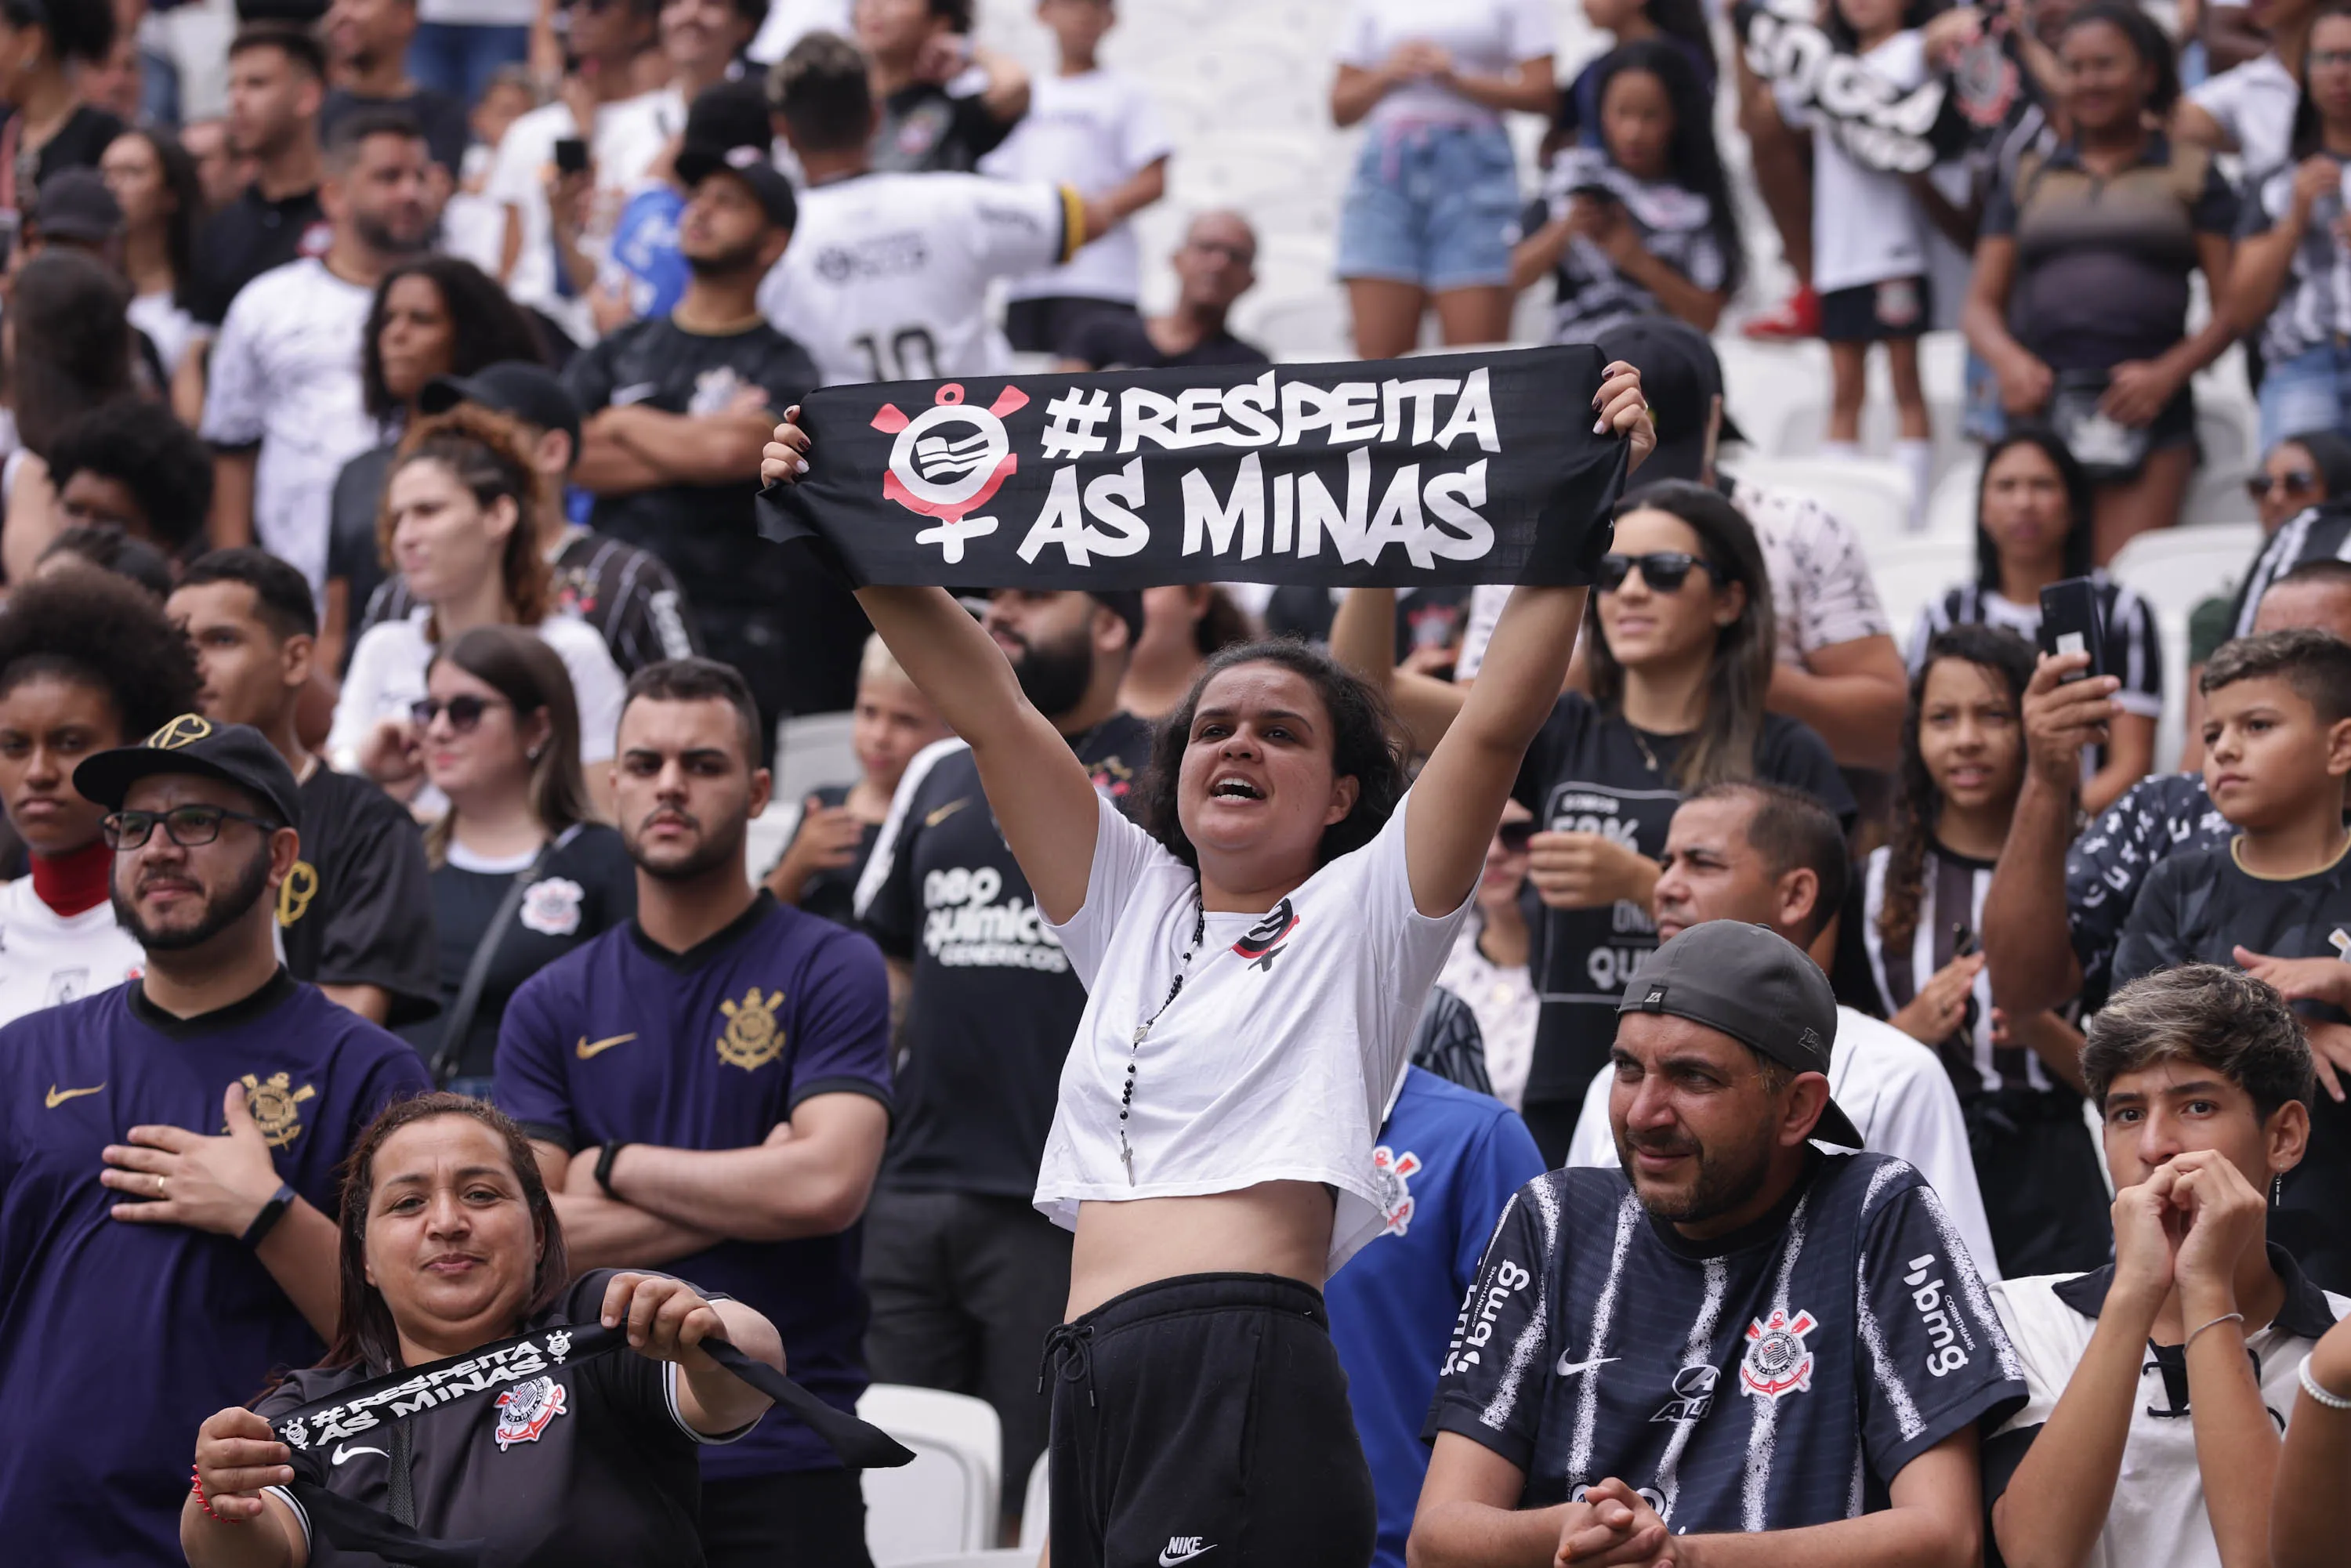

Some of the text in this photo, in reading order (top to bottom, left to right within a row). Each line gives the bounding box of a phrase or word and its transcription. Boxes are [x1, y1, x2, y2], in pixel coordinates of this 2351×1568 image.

[1041, 367, 1501, 459] #RESPEITA
[1017, 446, 1494, 570] AS MINAS
[1466, 1258, 1531, 1348] bmg
[1472, 1266, 1498, 1328] CORINTHIANS
[1911, 1278, 1969, 1378] bmg
[1944, 1295, 1976, 1352] CORINTHIANS
[310, 1341, 543, 1429] #RESPEITA
[315, 1354, 548, 1447] AS MINAS
[1166, 1536, 1203, 1555] NIKE
